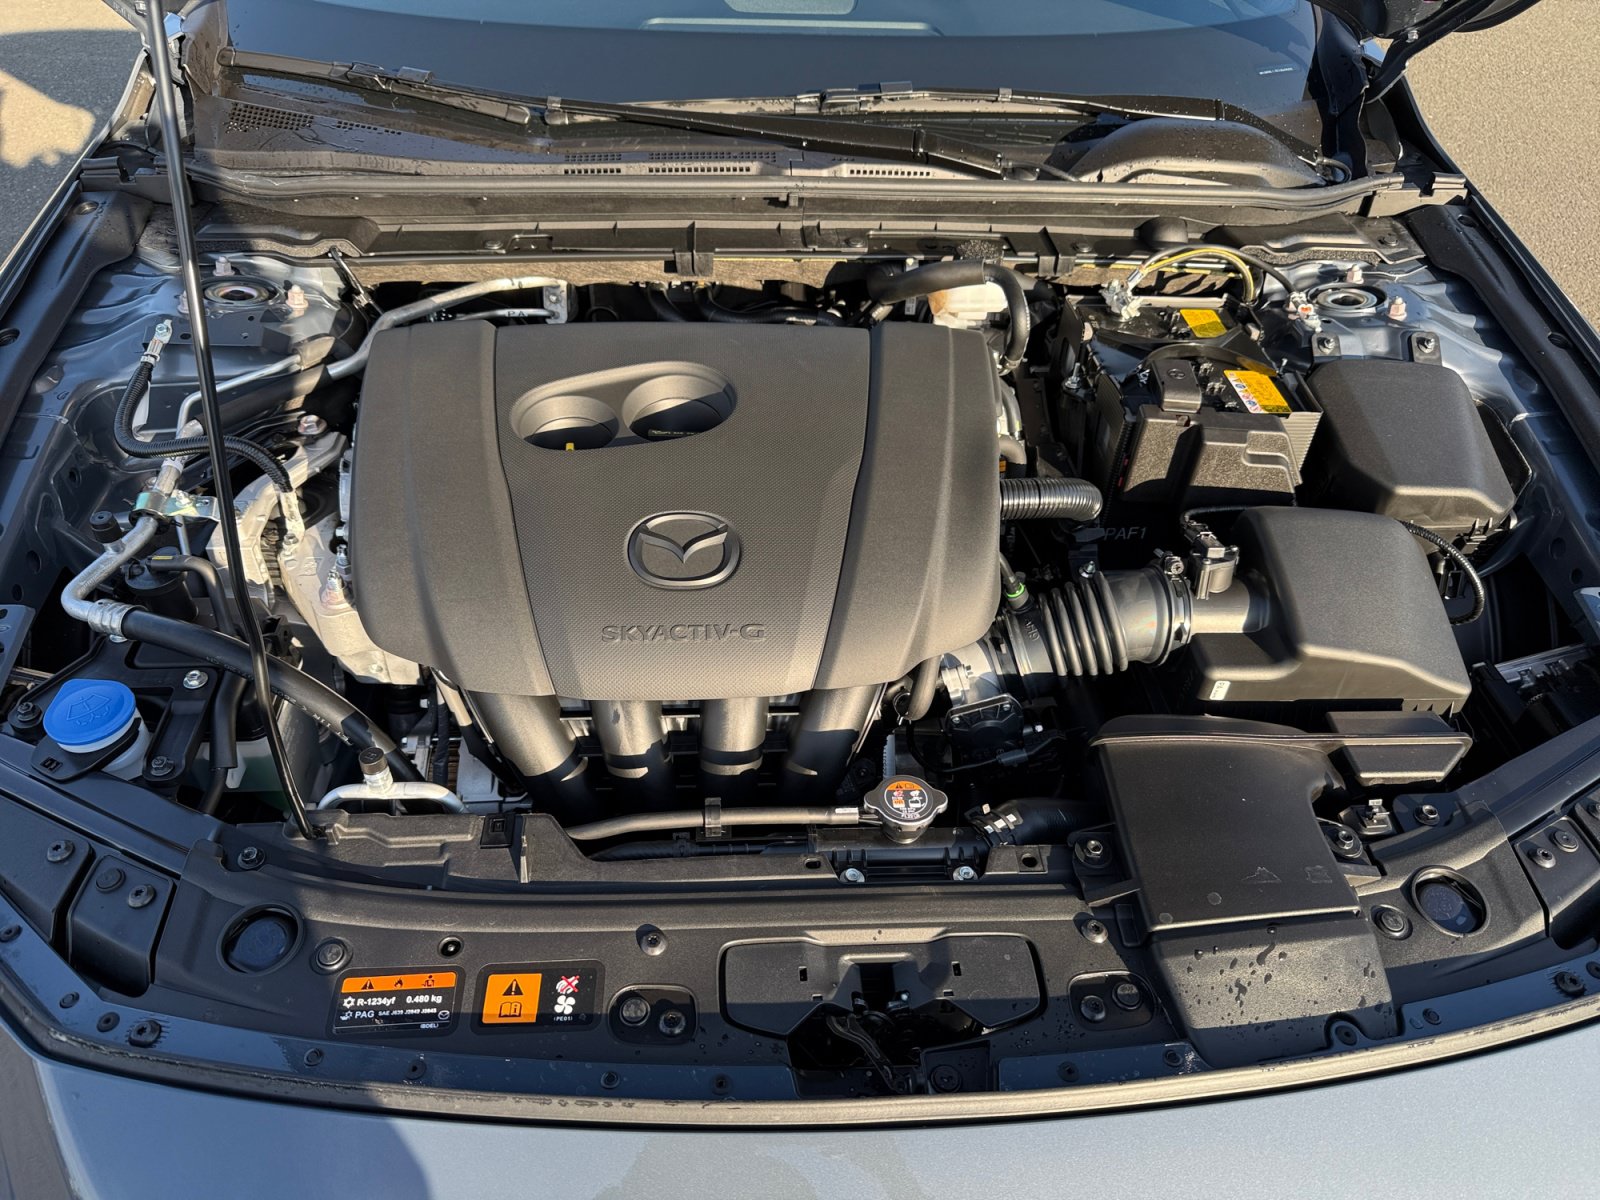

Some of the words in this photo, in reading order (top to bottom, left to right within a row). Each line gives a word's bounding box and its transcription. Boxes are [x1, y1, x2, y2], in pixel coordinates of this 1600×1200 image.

[1103, 526, 1148, 541] PAF1
[601, 624, 765, 642] SKYACTIV-G
[357, 996, 396, 1006] R-1234yf
[406, 995, 429, 1004] 0.480
[431, 994, 443, 1003] kg
[354, 1010, 375, 1019] PAG
